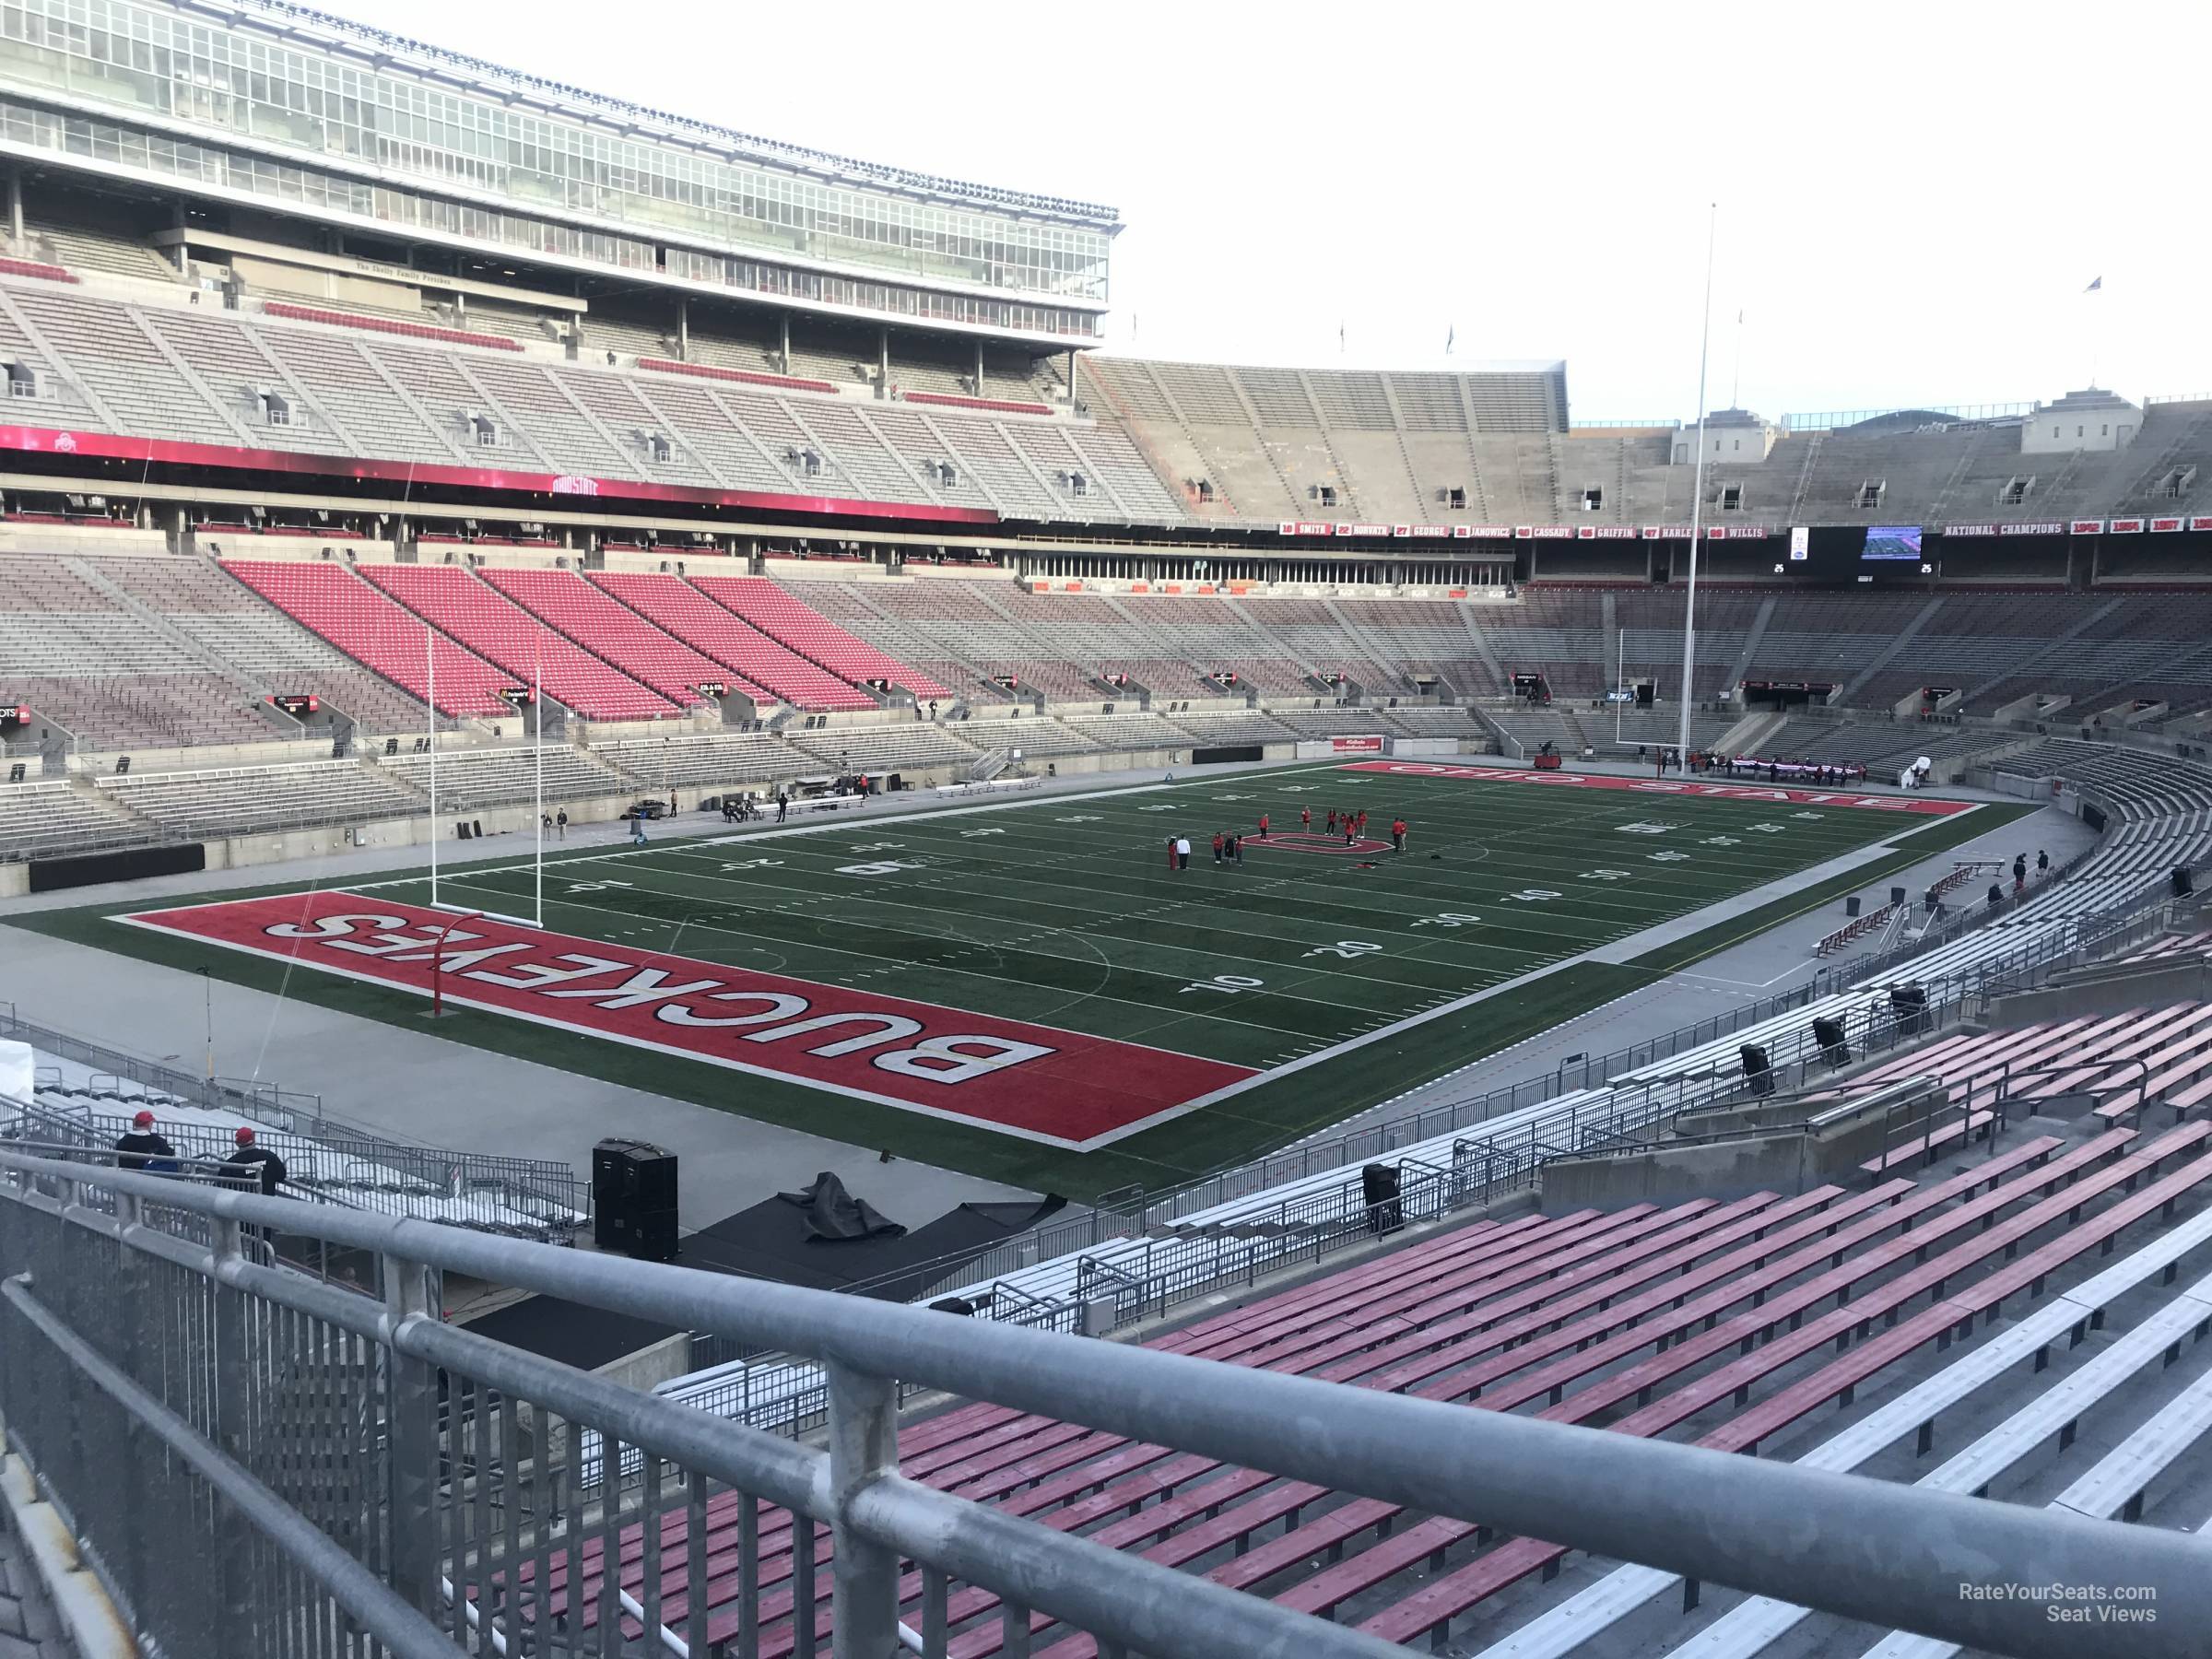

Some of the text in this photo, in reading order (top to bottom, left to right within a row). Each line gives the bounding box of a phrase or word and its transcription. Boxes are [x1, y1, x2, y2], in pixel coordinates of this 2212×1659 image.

[1299, 524, 1326, 535] SMITH
[1353, 525, 1387, 535] HORVATH
[1395, 526, 1445, 536] 27 GEORGE
[1470, 527, 1510, 536] JANOWICZ
[1534, 528, 1570, 537] CASSADY
[1597, 528, 1633, 537] GRIFFIN
[1729, 528, 1762, 537] WILLIS
[1945, 524, 2062, 535] NATIONAL CHAMPIONS
[1388, 764, 1921, 808] OHIO STATE
[722, 858, 784, 871] 20
[1578, 869, 1631, 881] 50
[568, 880, 633, 892] 10
[1508, 889, 1563, 902] 40
[1419, 912, 1482, 927] 30
[1312, 940, 1382, 959] 20
[1190, 975, 1265, 994] 10
[264, 913, 1058, 1085] BUCKEYES
